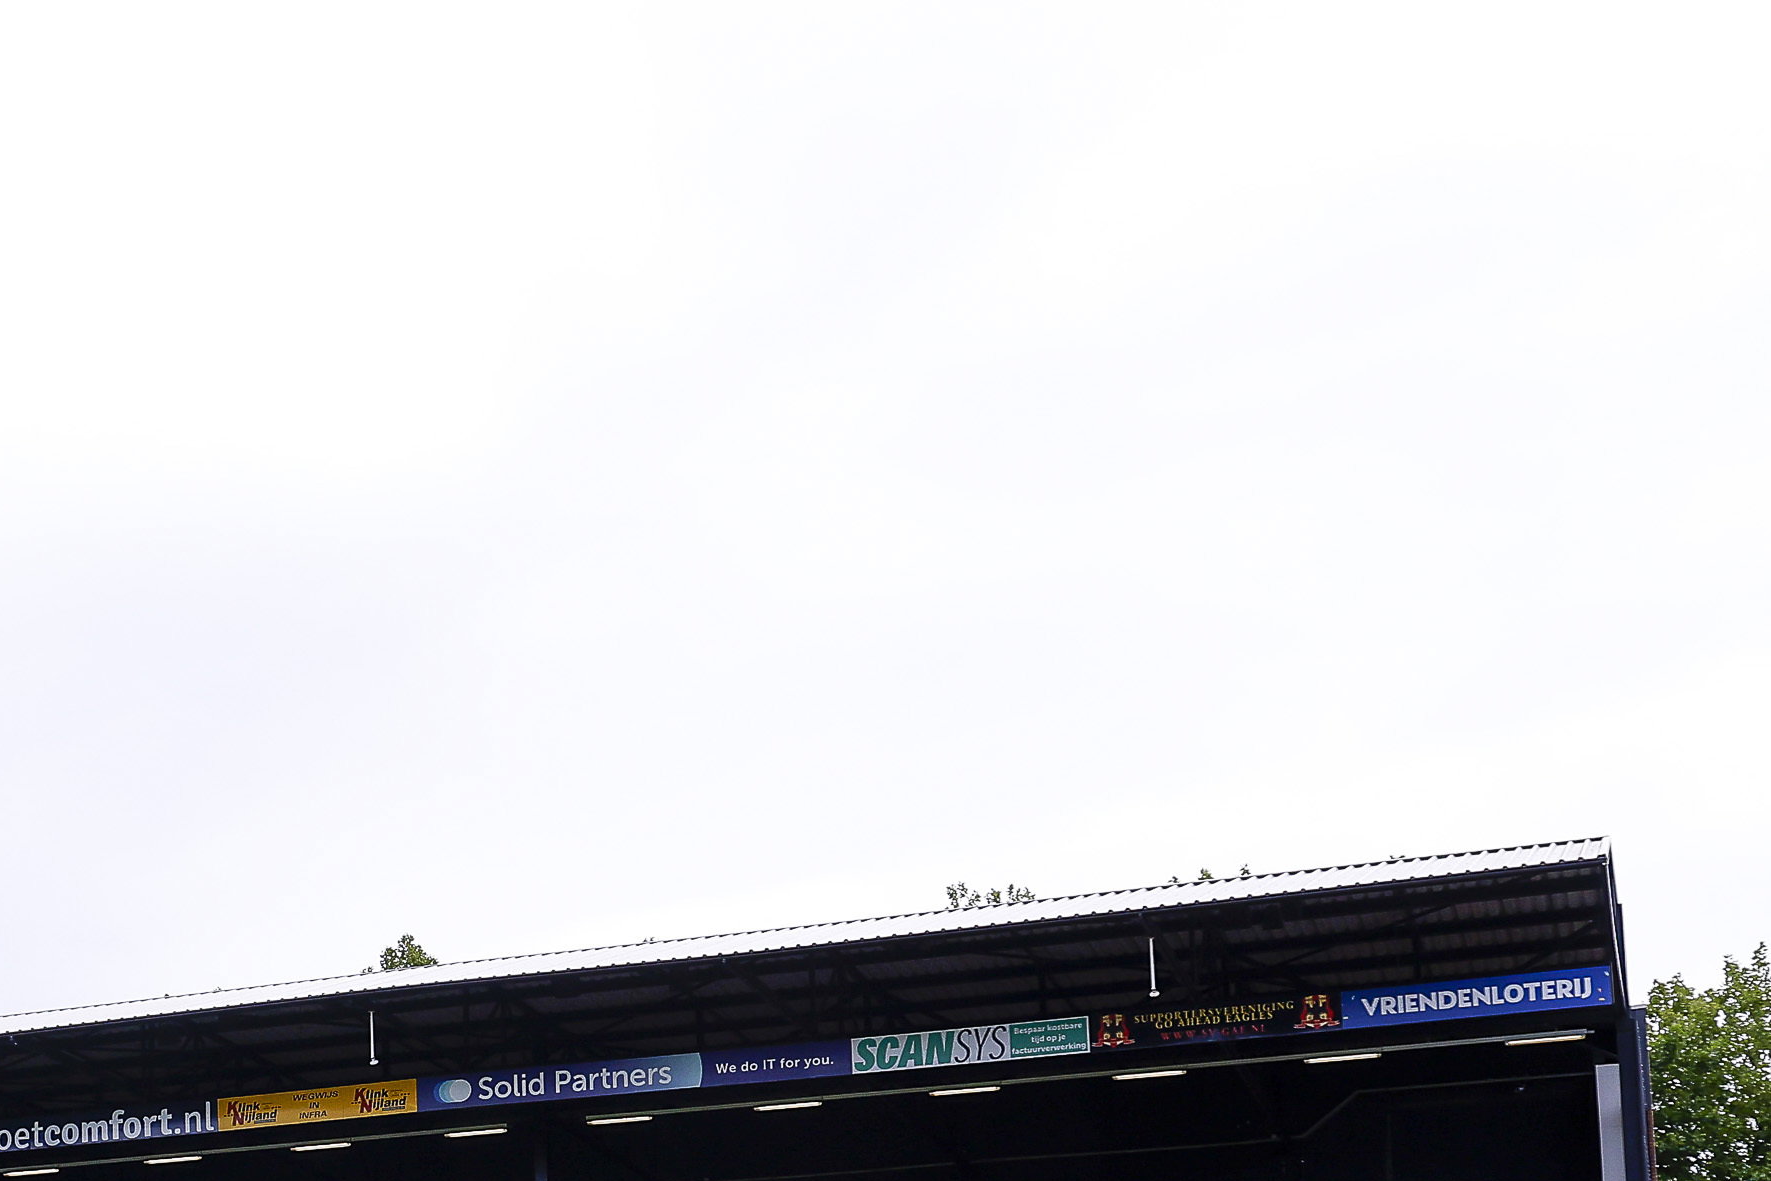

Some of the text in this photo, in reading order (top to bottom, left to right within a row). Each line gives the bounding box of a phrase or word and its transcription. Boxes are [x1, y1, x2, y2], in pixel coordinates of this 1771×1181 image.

[1361, 977, 1592, 1016] VRIENDENLOTERIJ
[1155, 1010, 1274, 1029] GO AHEAD EAGLES
[1013, 1021, 1083, 1035] Bespaar kostbare
[1031, 1034, 1045, 1044] tijd
[1058, 1033, 1066, 1043] je
[854, 1025, 1007, 1072] SCANSYS
[1011, 1041, 1087, 1055] factuurverwerking
[715, 1055, 834, 1075] We do IT for you.
[478, 1063, 672, 1100] Solid Partners
[292, 1090, 339, 1102] WEGWIJS
[355, 1087, 388, 1101] Klink
[227, 1100, 260, 1115] Klink
[309, 1101, 319, 1109] IN
[360, 1095, 407, 1113] Nijland
[232, 1109, 277, 1126] Nijland
[299, 1109, 328, 1120] INFRA
